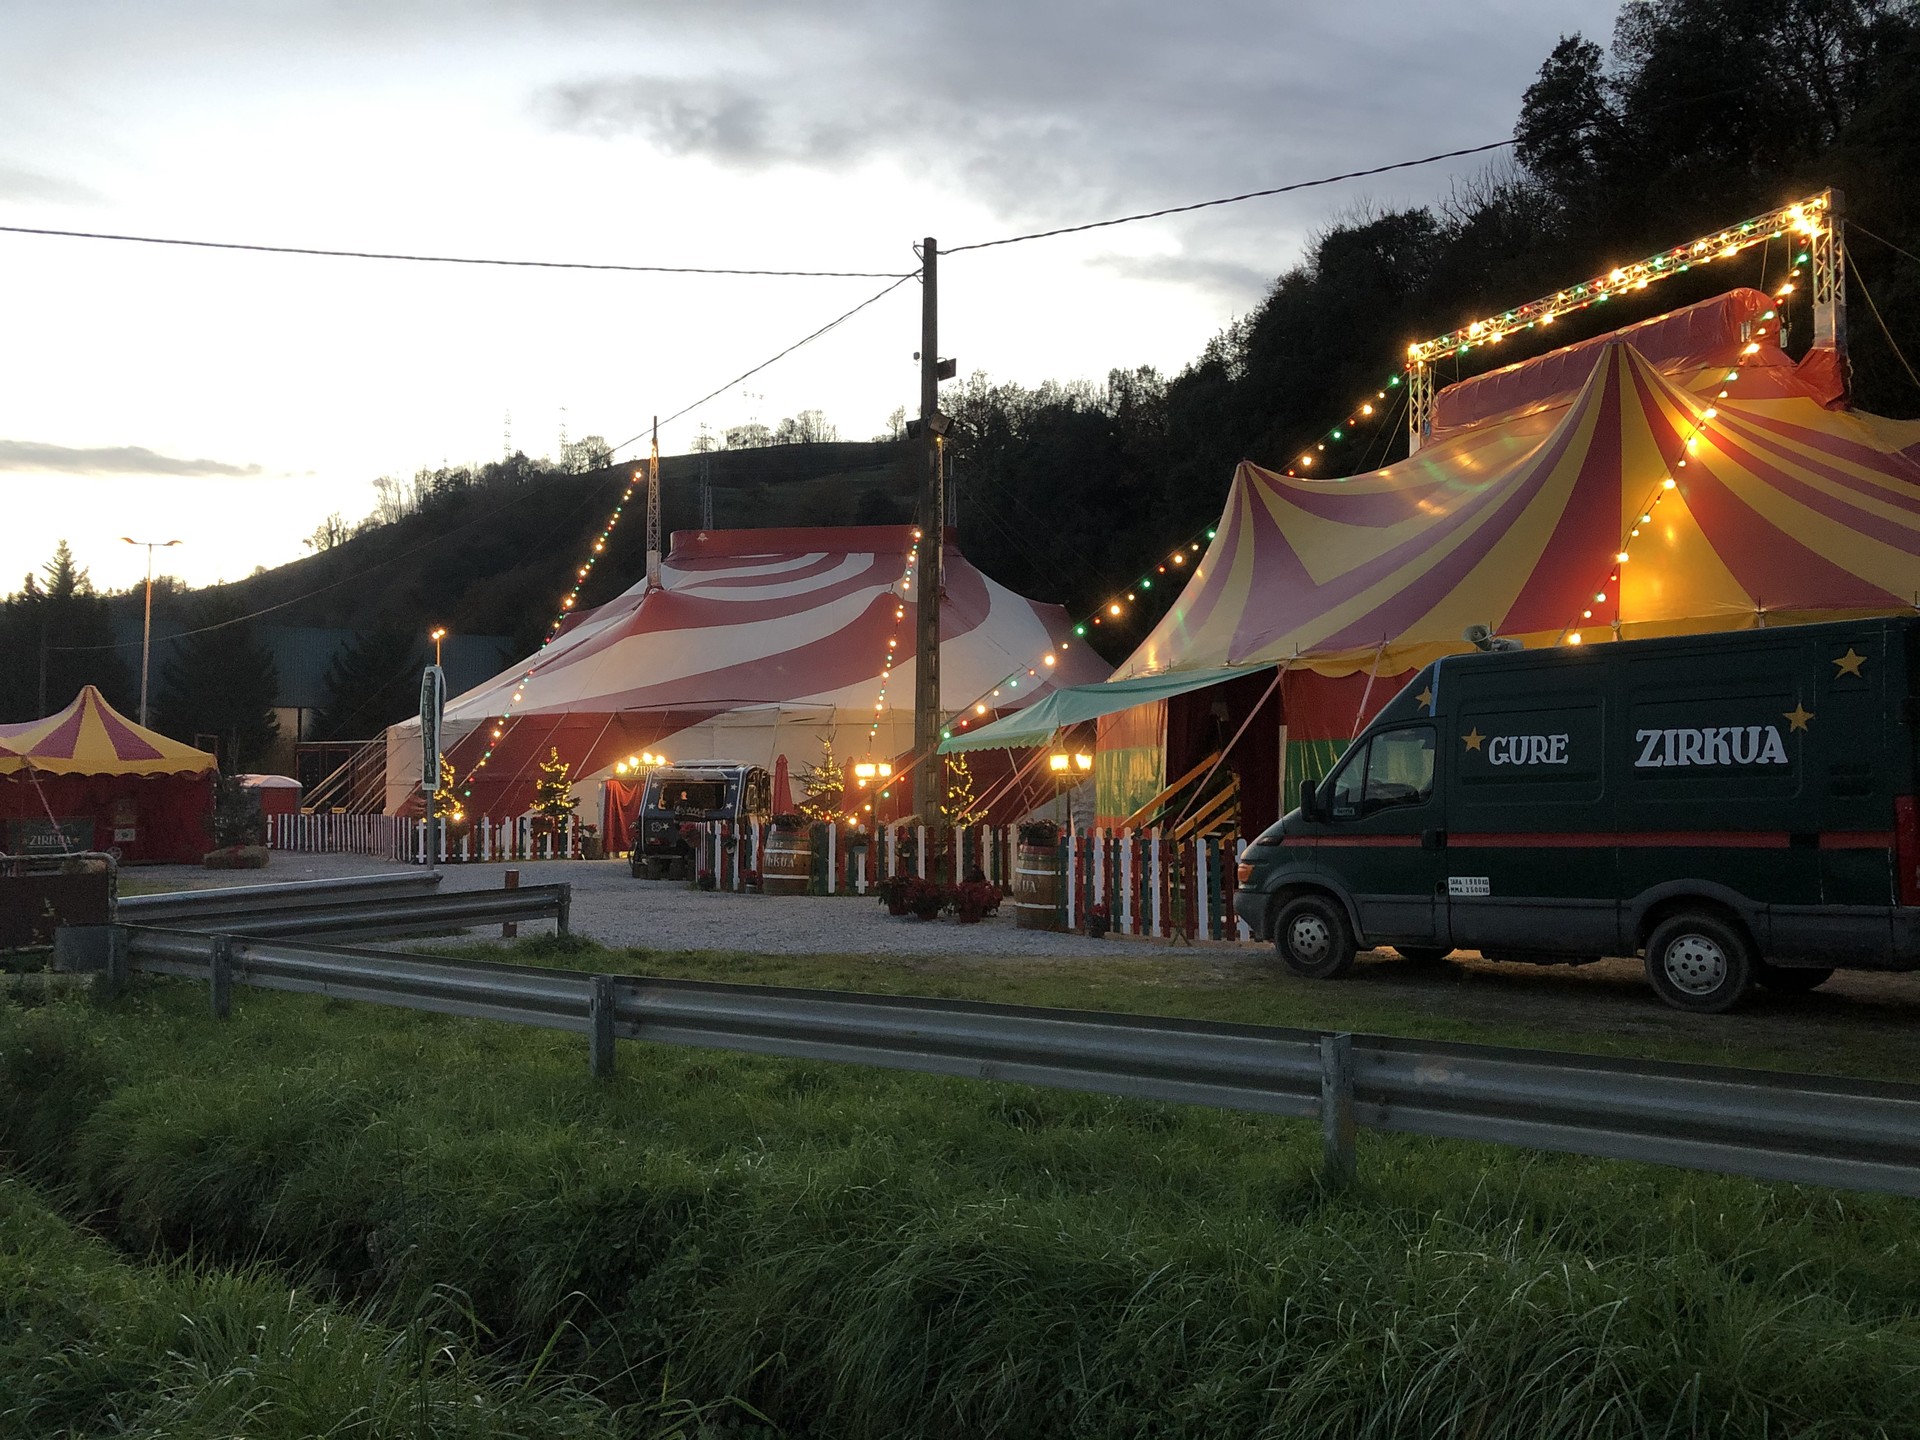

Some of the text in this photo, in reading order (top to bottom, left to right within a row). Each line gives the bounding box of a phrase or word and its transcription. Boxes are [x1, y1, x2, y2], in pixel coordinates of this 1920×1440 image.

[1488, 725, 1789, 768] GURE ZIRKUA
[29, 835, 72, 846] ZIRKUA
[764, 853, 795, 868] IRKUA
